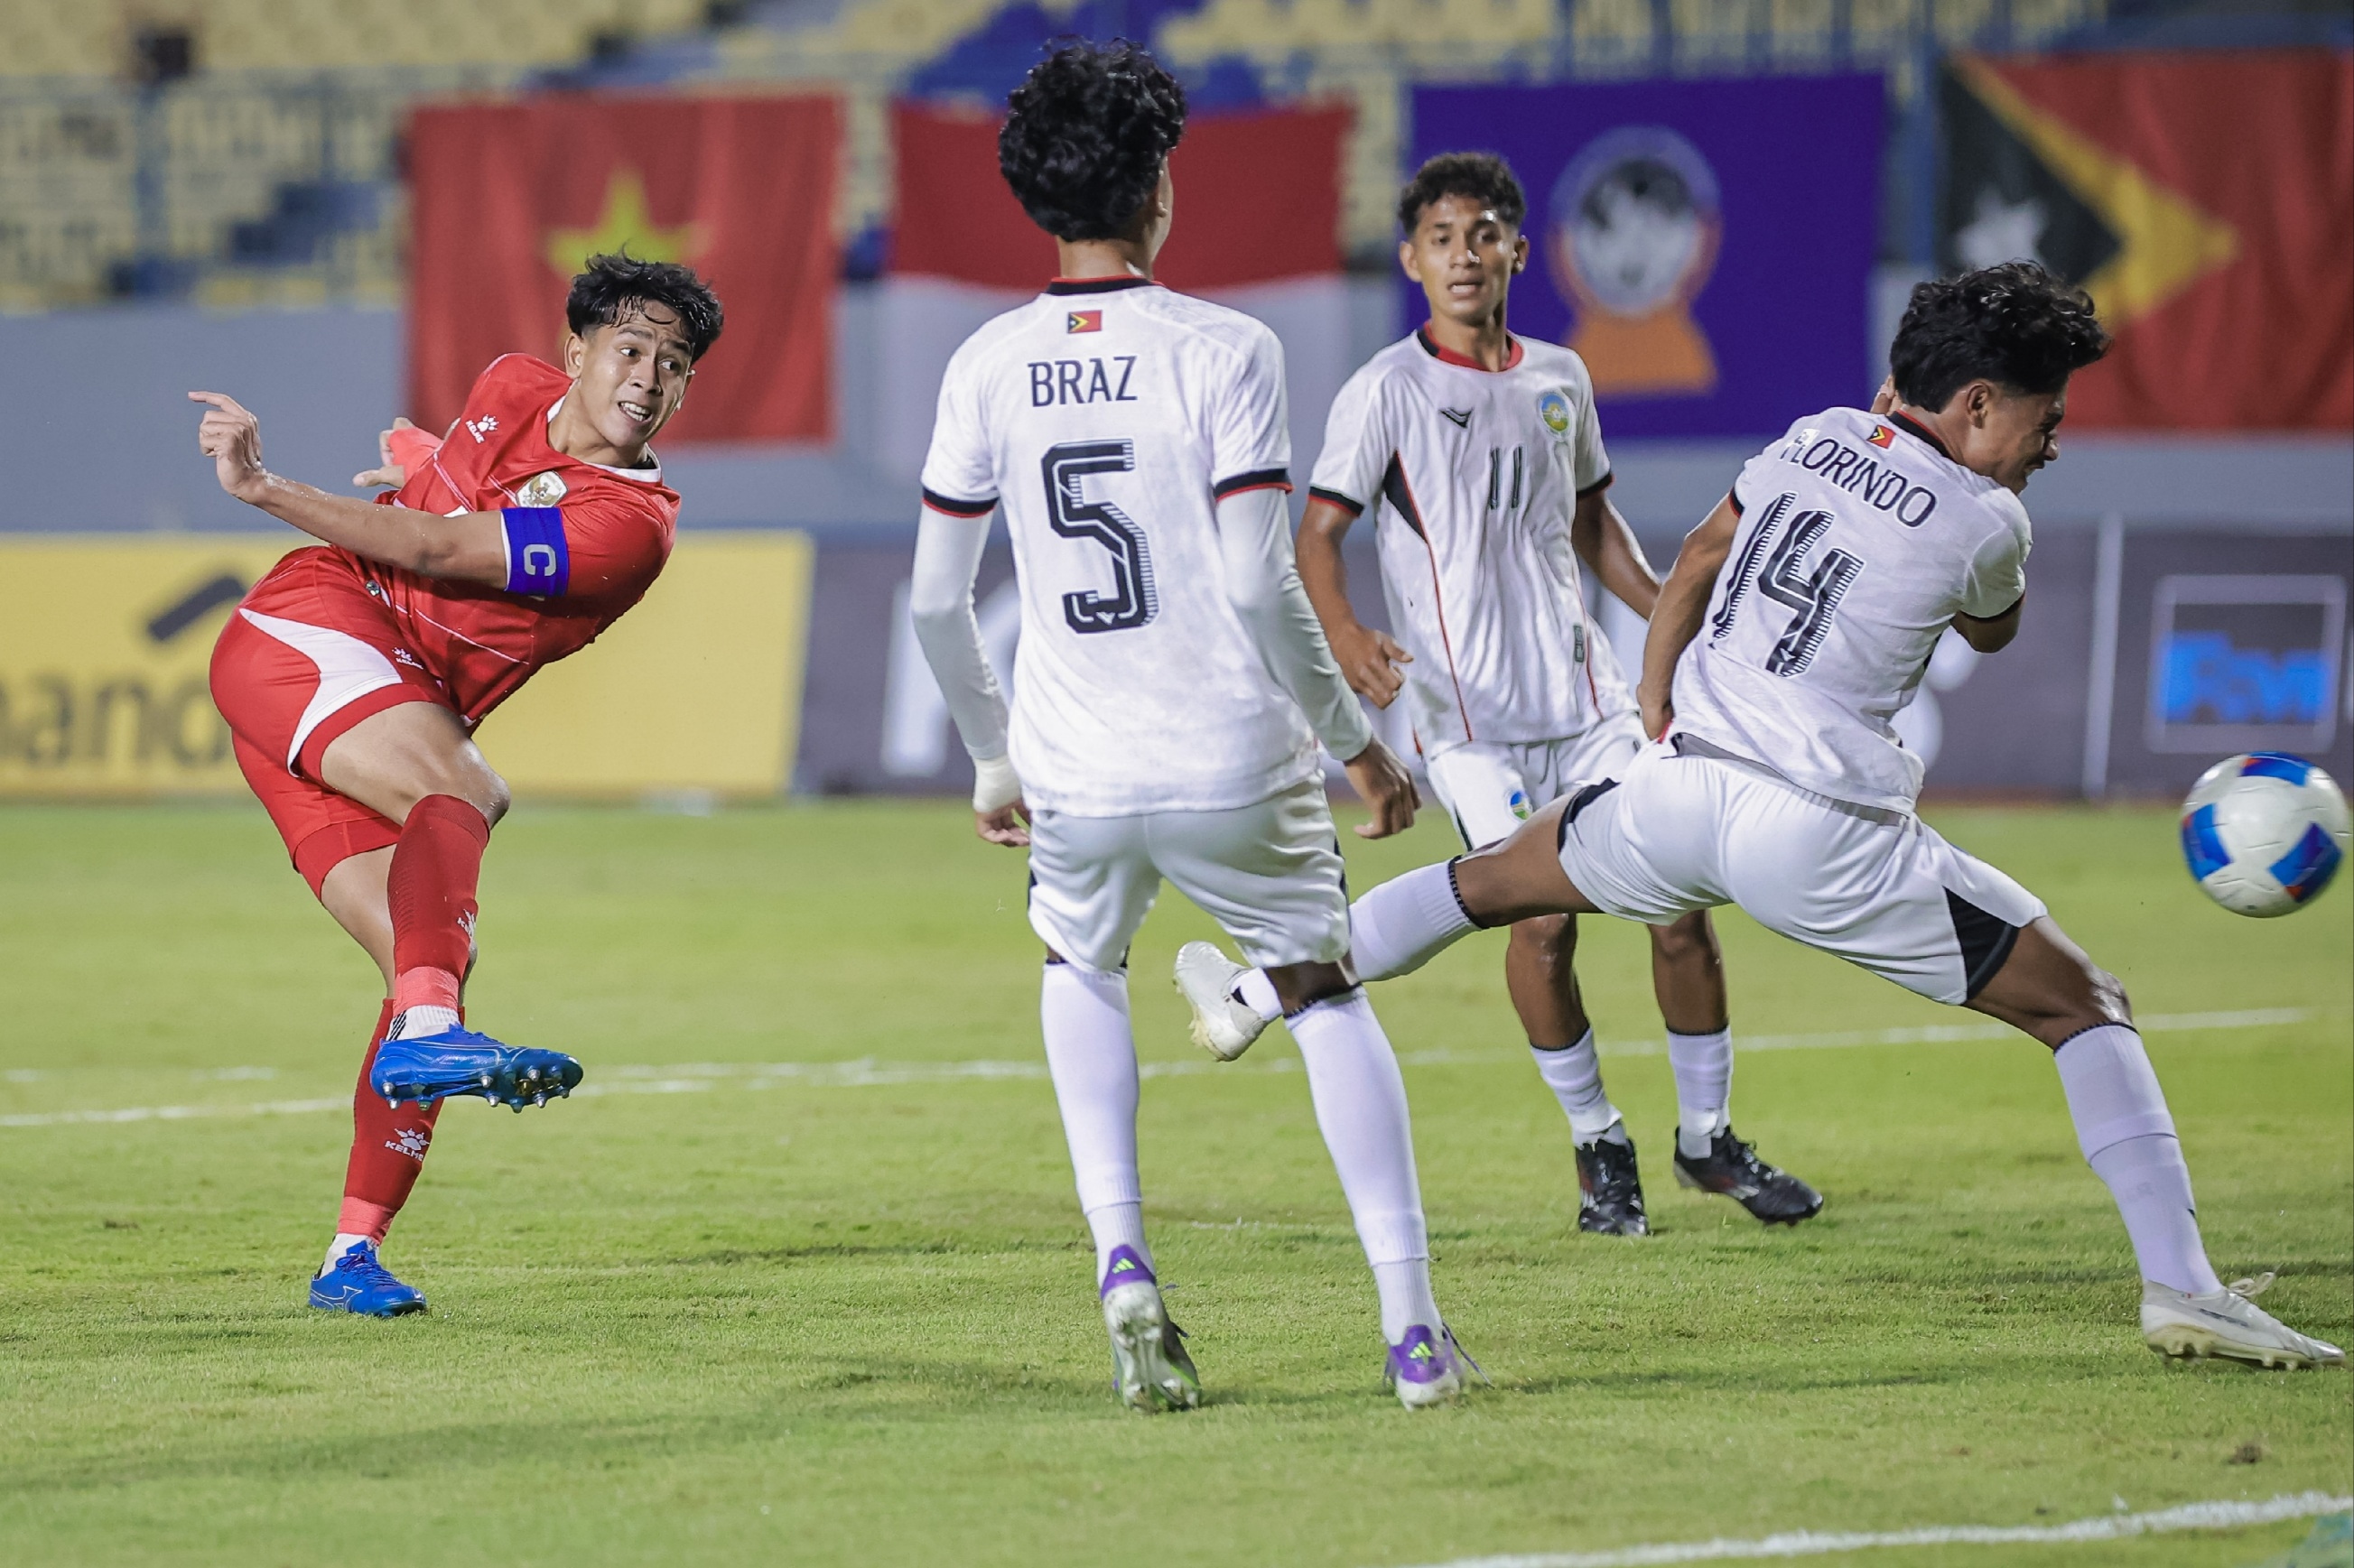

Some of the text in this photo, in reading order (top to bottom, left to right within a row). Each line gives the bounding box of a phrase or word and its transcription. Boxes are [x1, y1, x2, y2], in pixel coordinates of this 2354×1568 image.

[1028, 356, 1138, 407] BRAZ
[465, 420, 485, 443] KELME
[1490, 445, 1523, 510] 11
[523, 543, 557, 576] C
[1040, 438, 1159, 634] 5
[1708, 491, 1866, 678] 14
[384, 1140, 424, 1162] KELME
